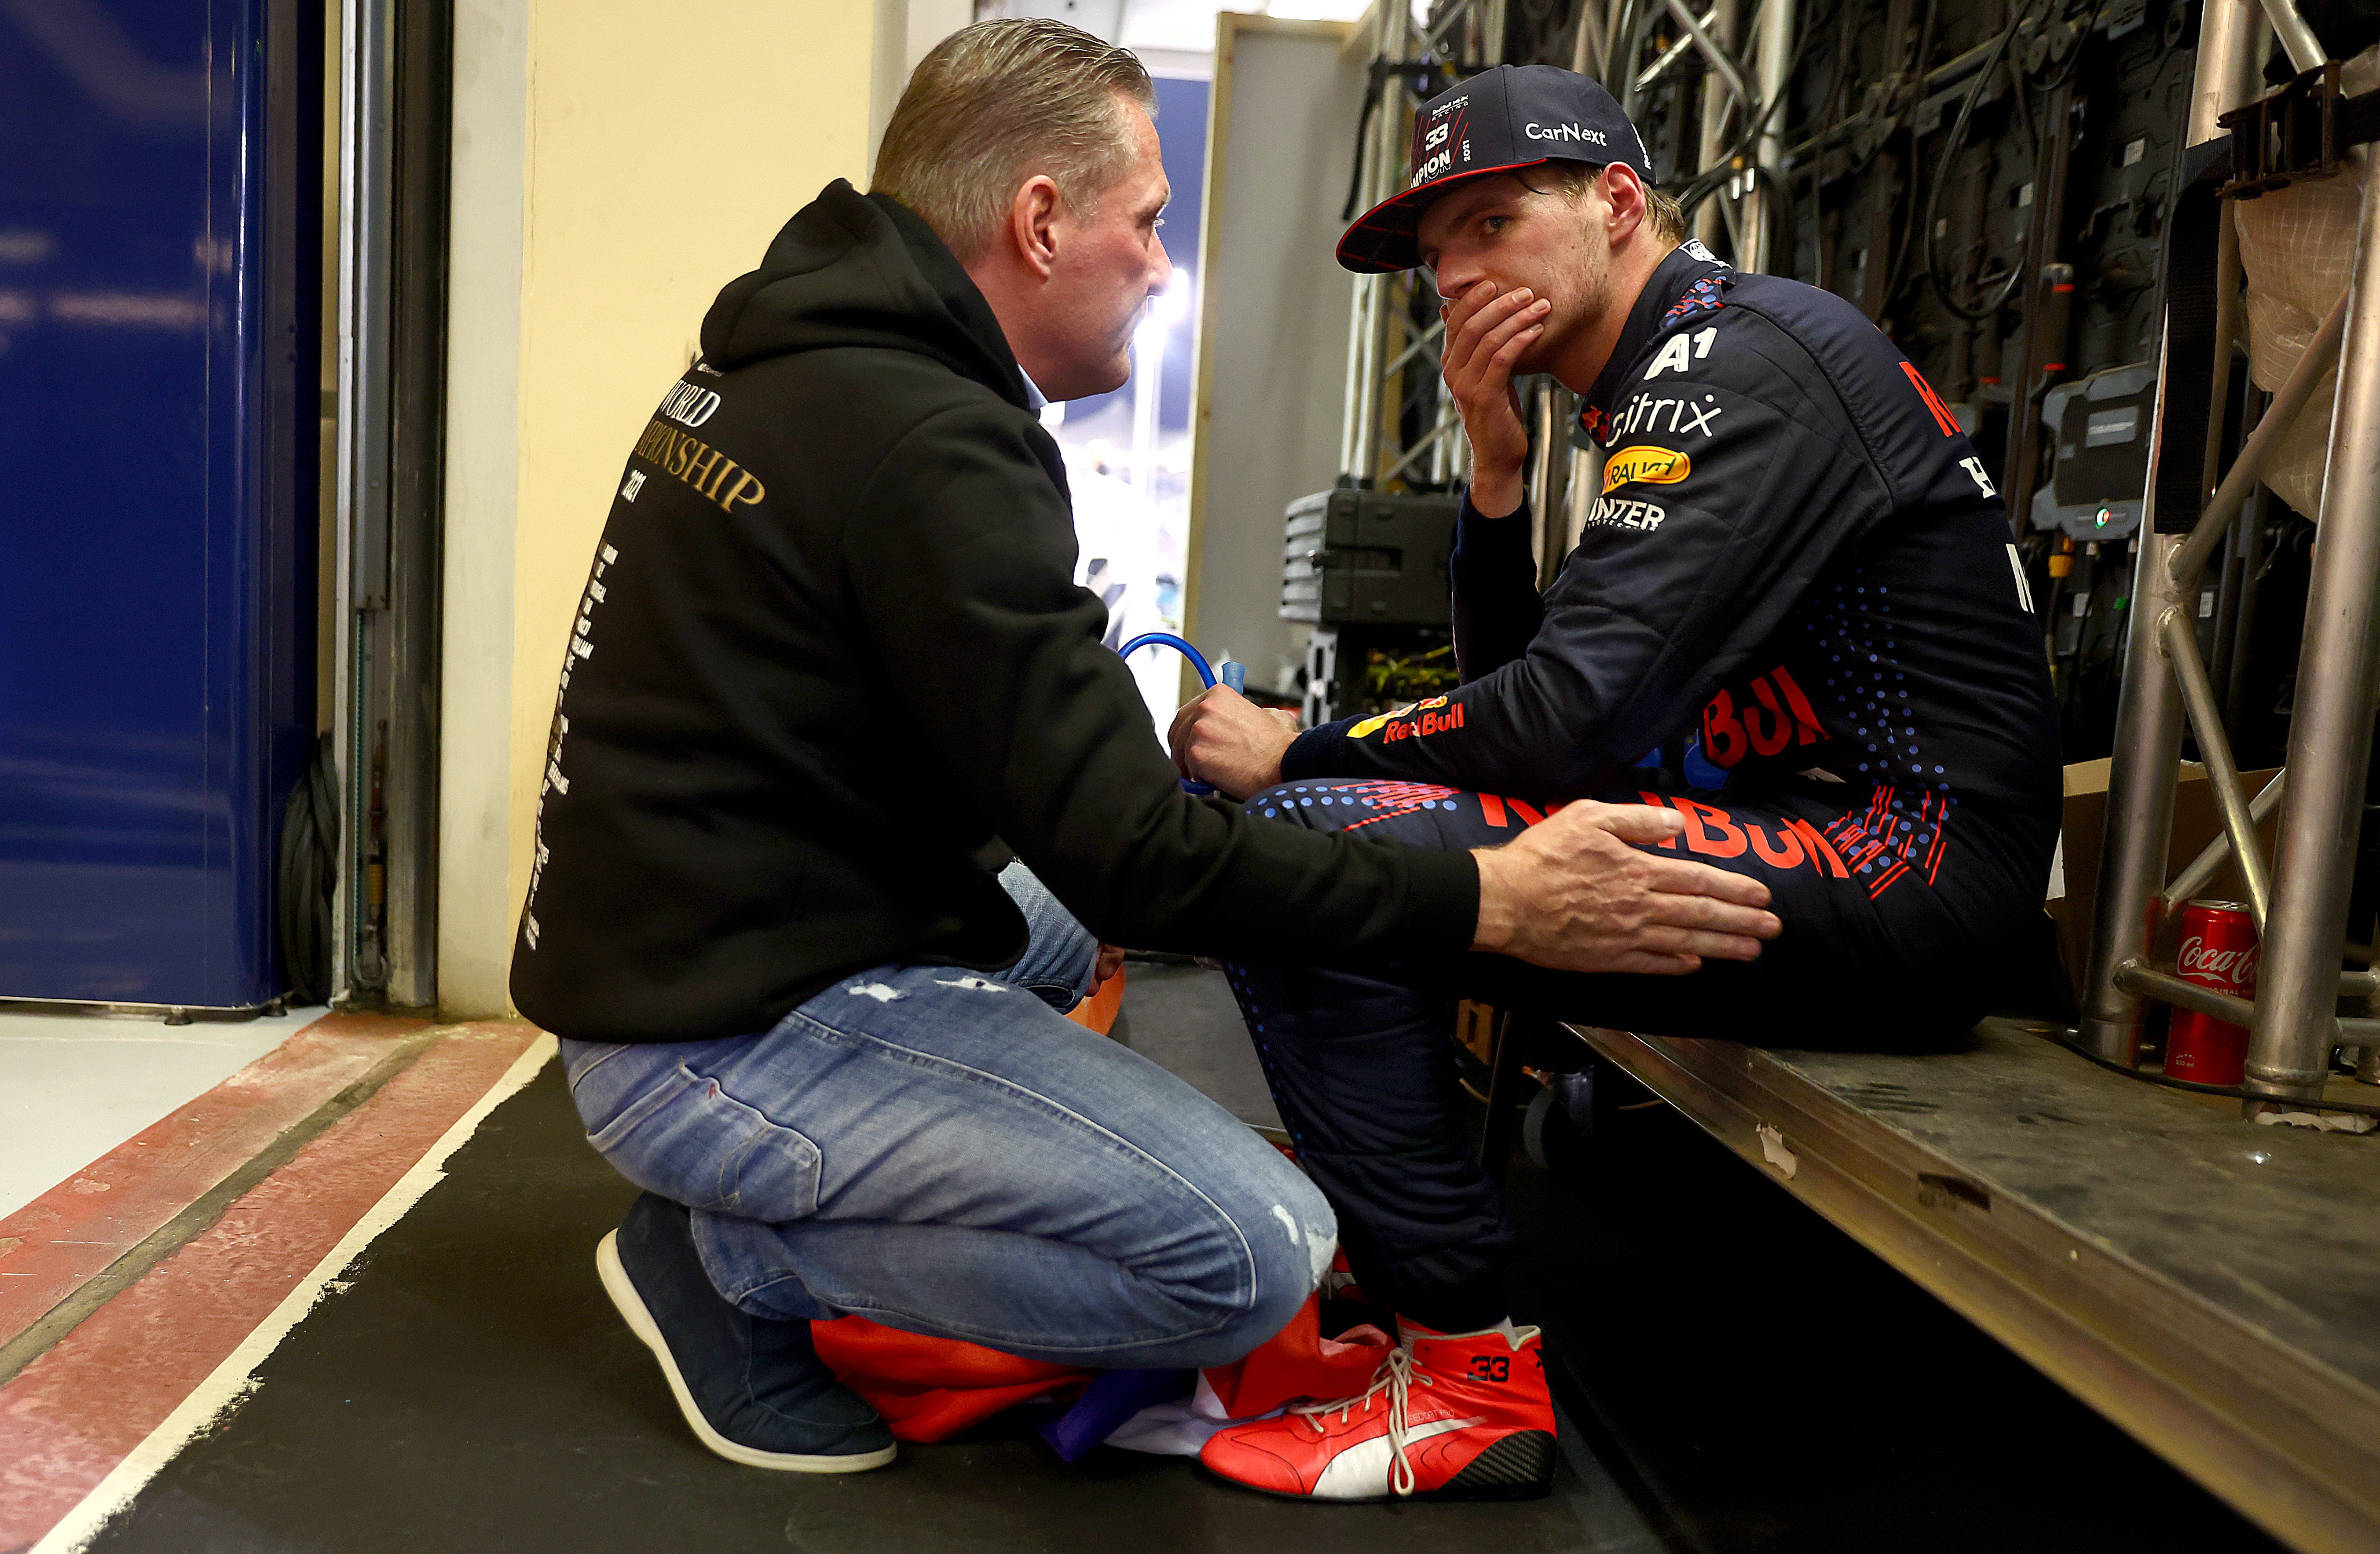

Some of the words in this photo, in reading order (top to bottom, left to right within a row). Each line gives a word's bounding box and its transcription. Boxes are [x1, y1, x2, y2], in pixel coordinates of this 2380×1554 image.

[1425, 122, 1449, 151] 33
[1525, 122, 1607, 146] CarNext
[1462, 139, 1471, 162] 2021
[1643, 326, 1718, 381] A1
[1588, 497, 1666, 530] INTER
[1383, 715, 1422, 744] Red
[1422, 702, 1465, 736] Bull
[1467, 1356, 1510, 1382] 33
